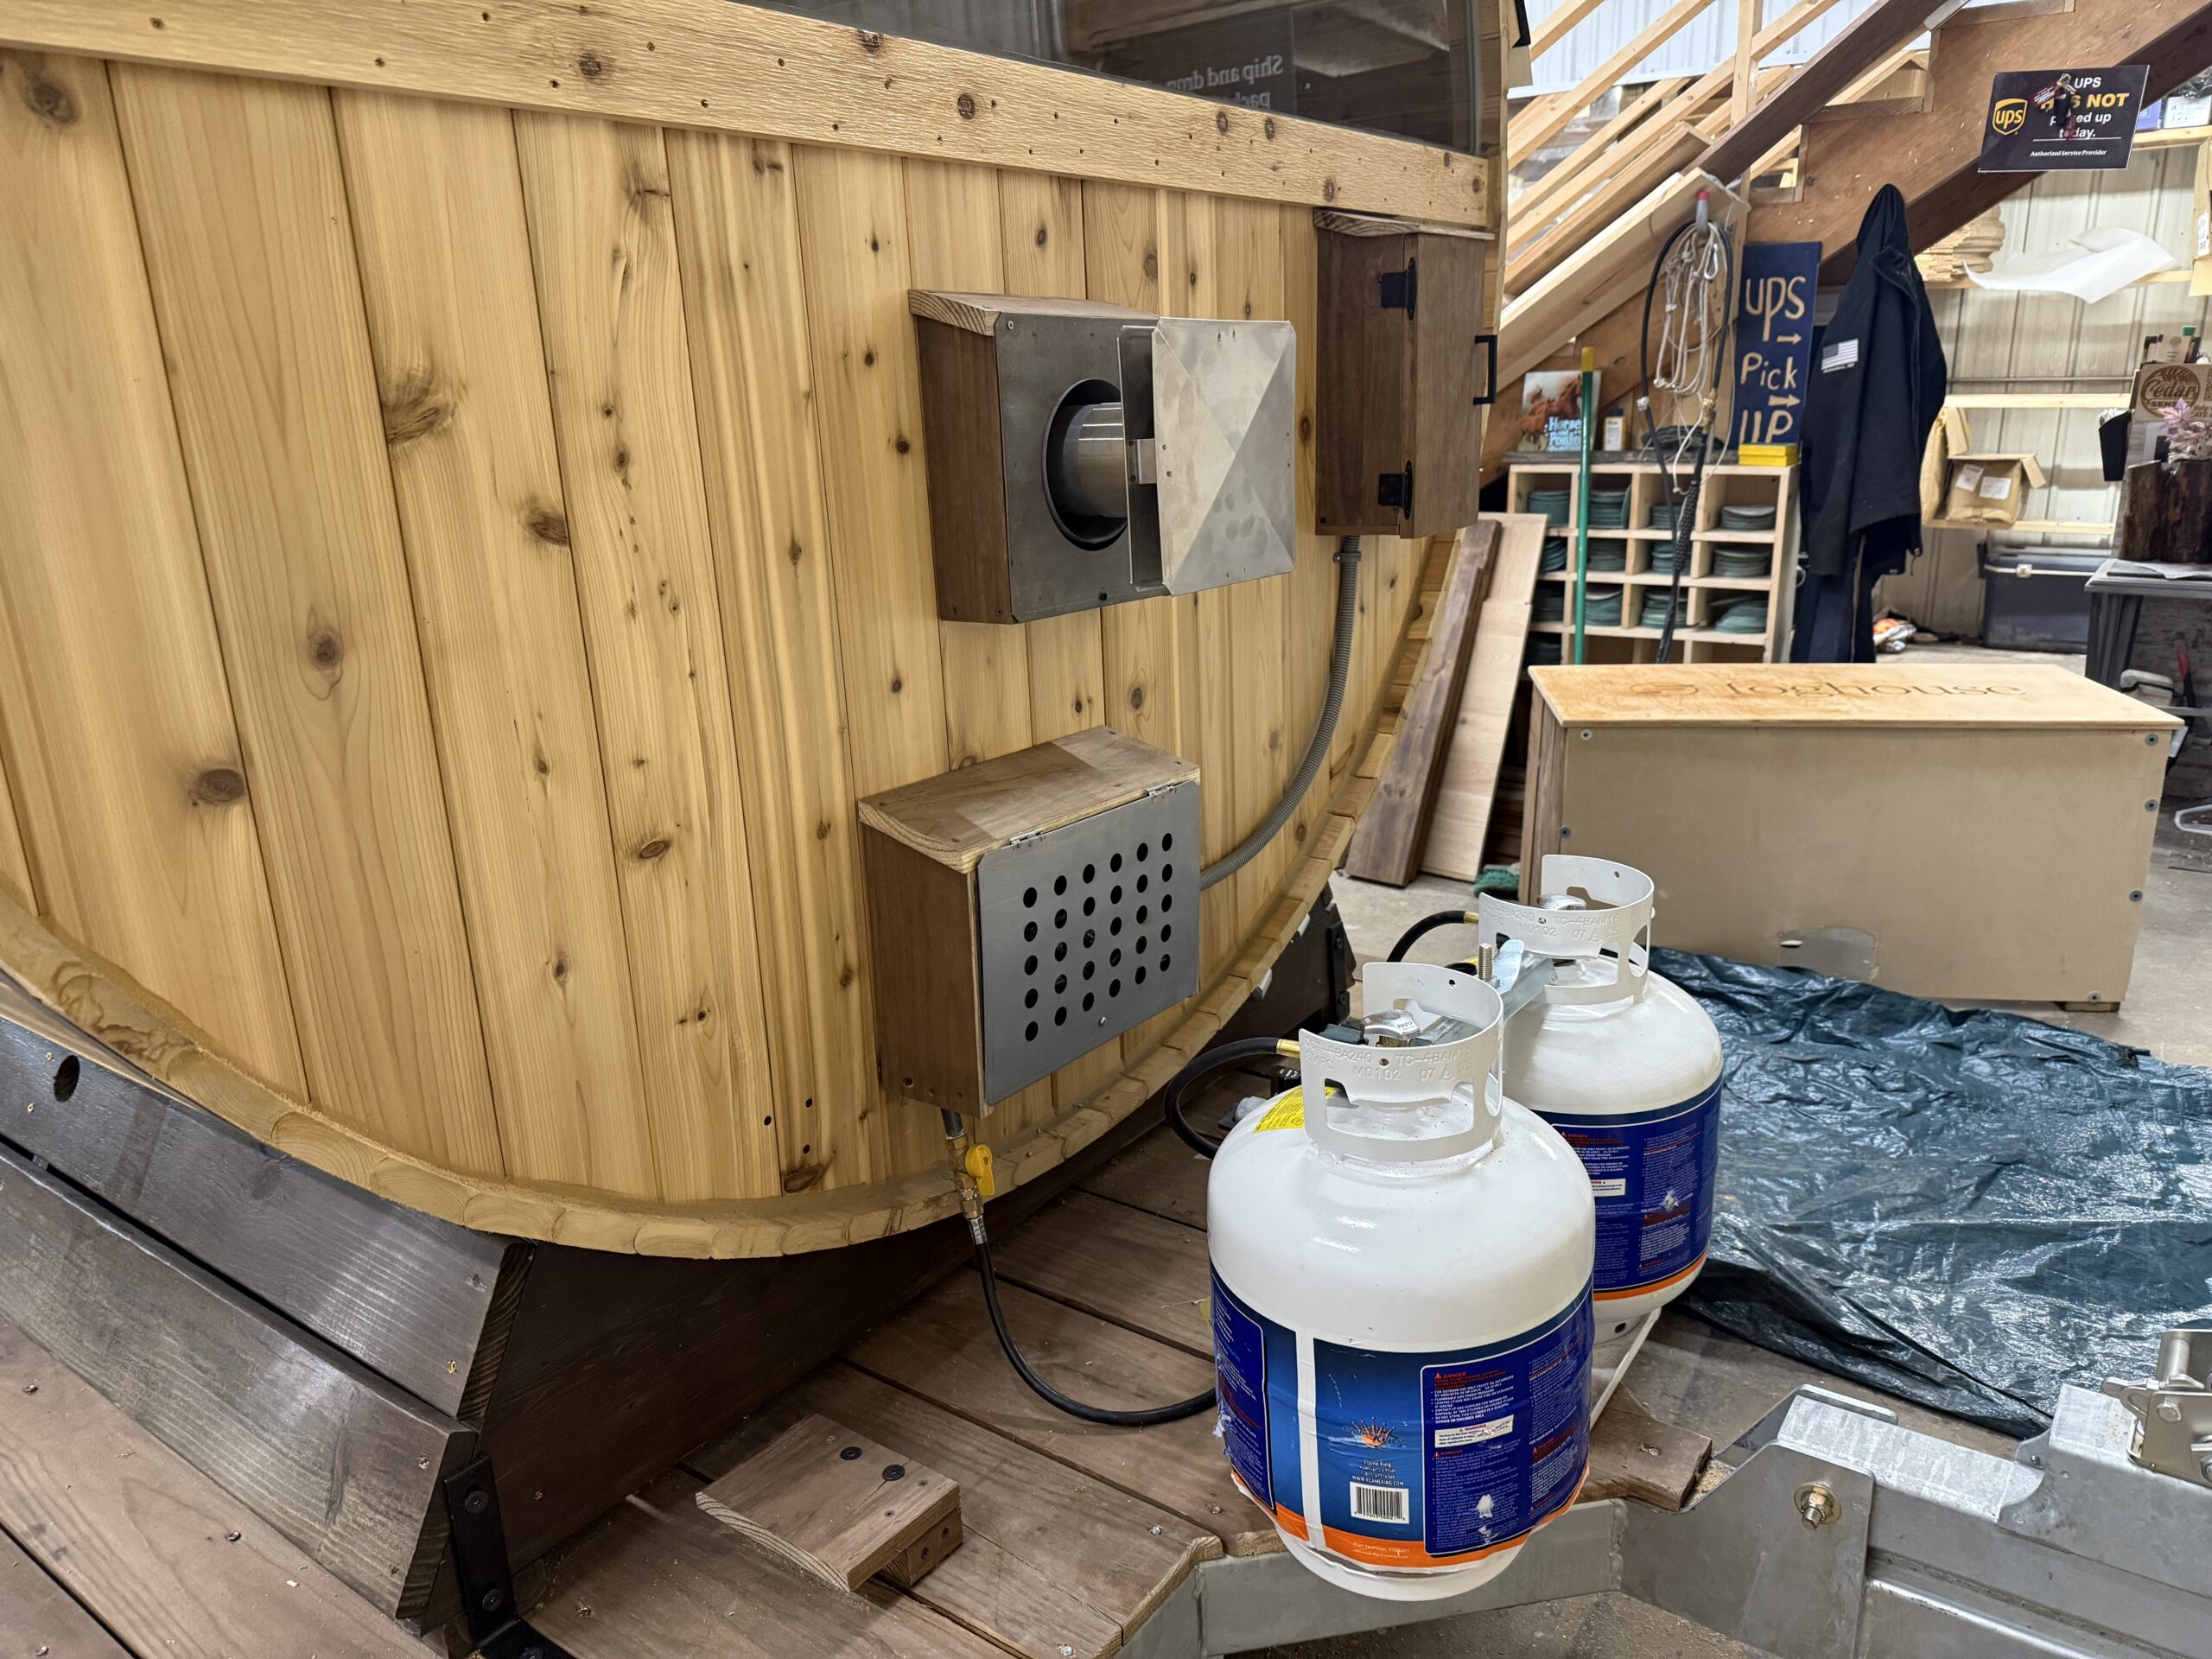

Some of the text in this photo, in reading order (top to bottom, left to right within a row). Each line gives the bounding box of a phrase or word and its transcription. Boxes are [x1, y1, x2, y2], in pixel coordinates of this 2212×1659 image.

[2075, 77, 2101, 89] UPS
[2086, 92, 2130, 109] NOT
[1995, 109, 2024, 130] ups
[2094, 113, 2112, 125] up
[1740, 352, 1798, 391] Pick
[2145, 379, 2196, 398] Cedar
[1738, 409, 1794, 444] UP
[1727, 681, 2026, 697] loghouse
[1353, 1065, 1402, 1081] M0102
